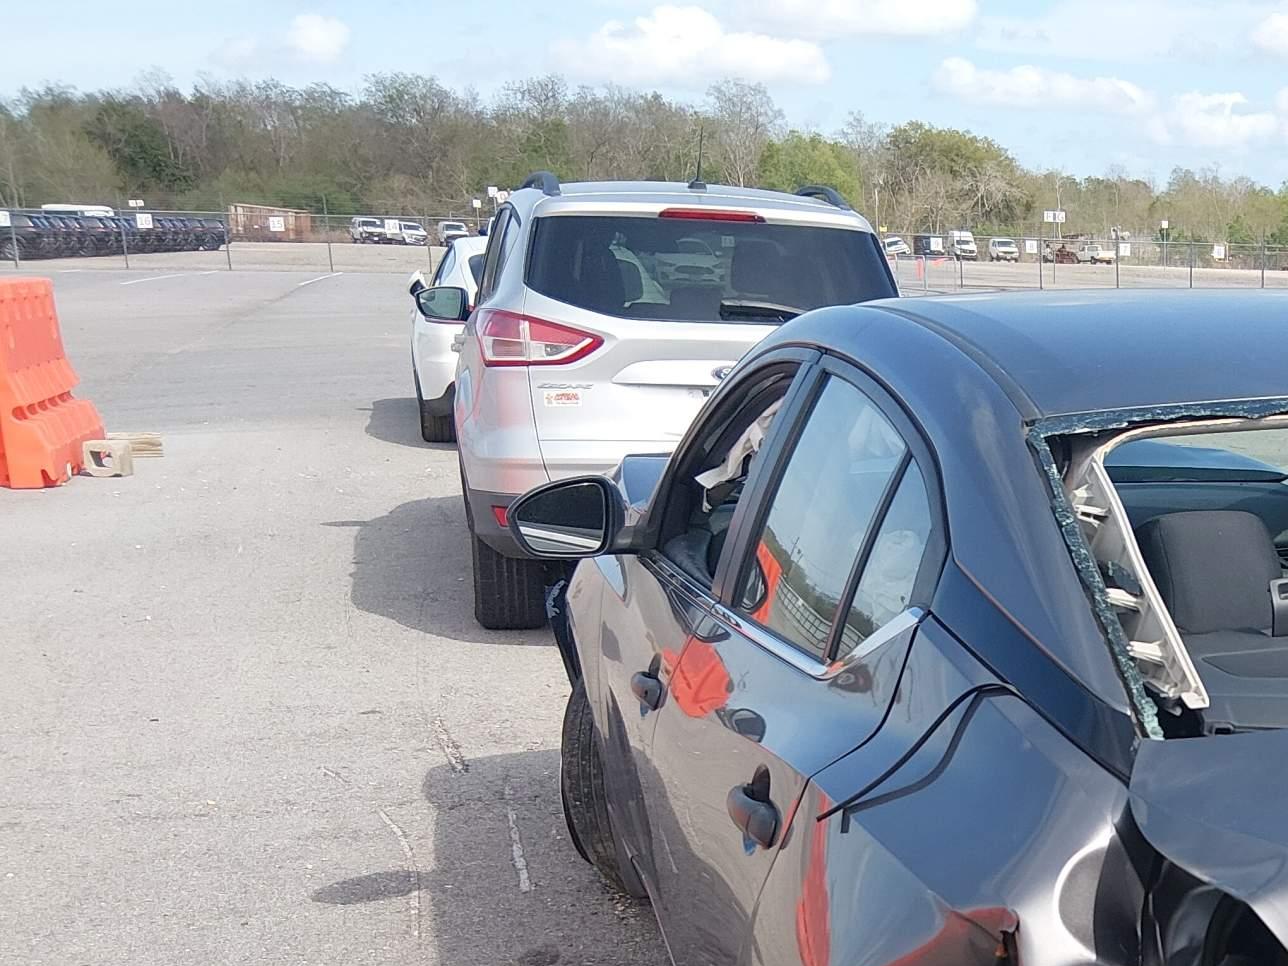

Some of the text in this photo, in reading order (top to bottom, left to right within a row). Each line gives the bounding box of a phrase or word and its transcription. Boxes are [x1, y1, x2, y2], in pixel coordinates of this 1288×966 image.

[138, 216, 151, 227] 16
[271, 219, 282, 229] 15
[386, 220, 398, 231] 14
